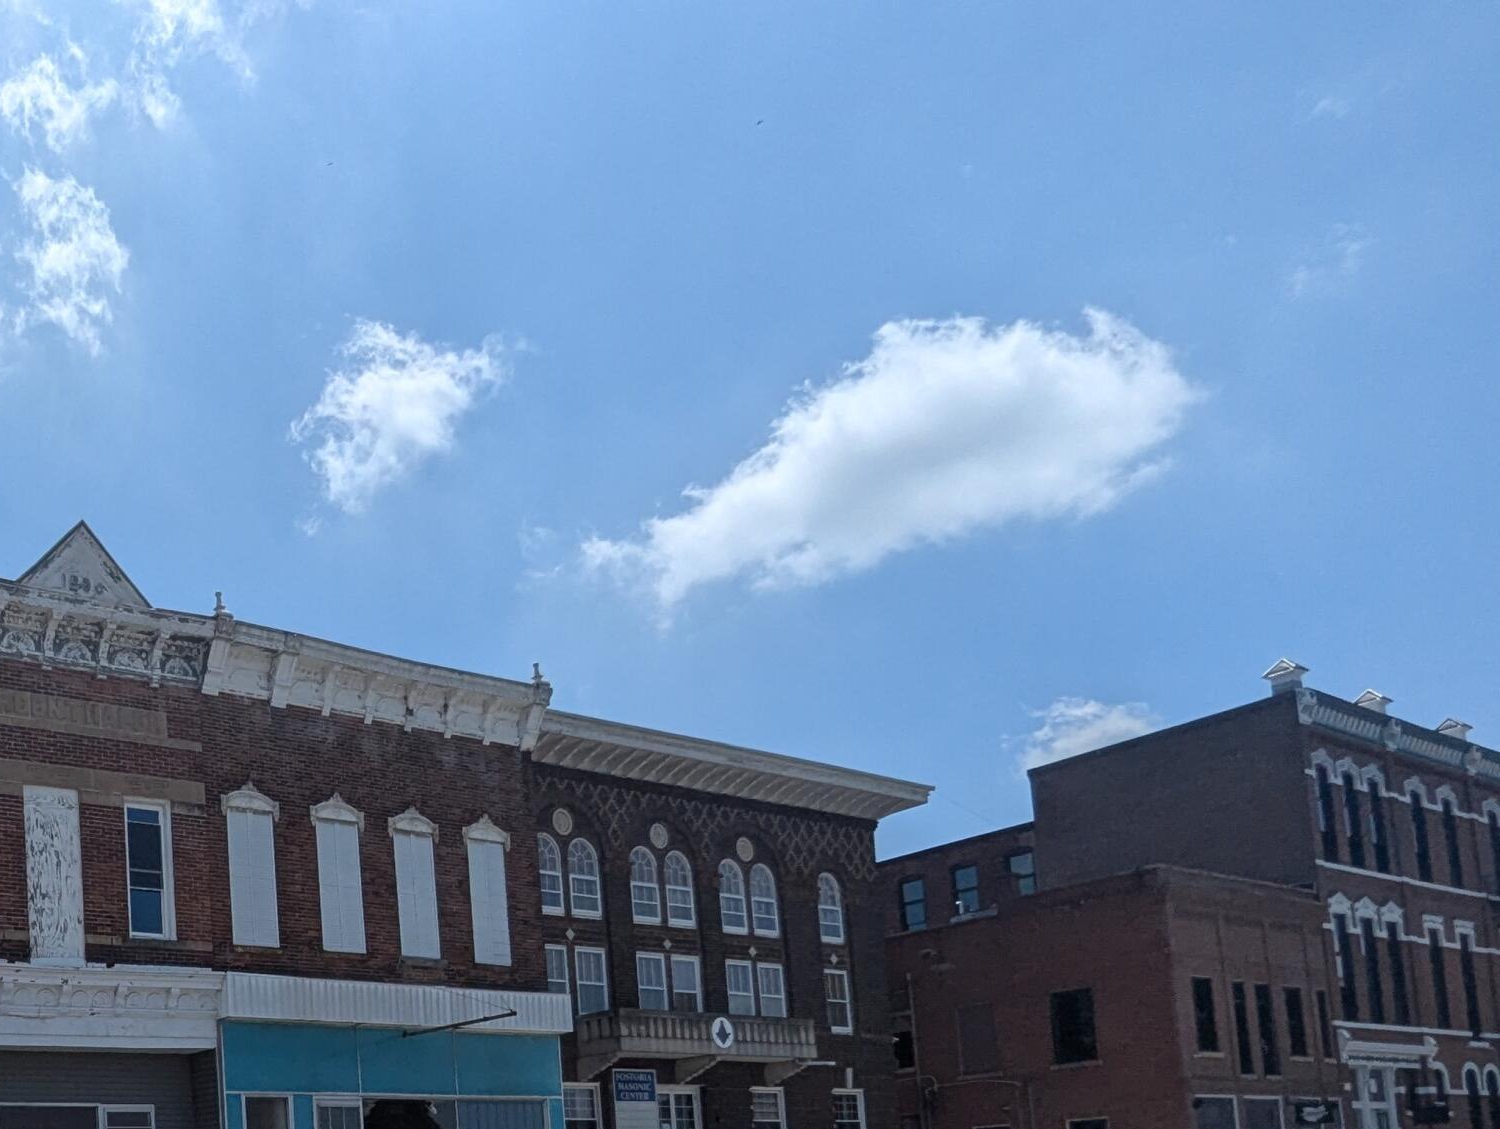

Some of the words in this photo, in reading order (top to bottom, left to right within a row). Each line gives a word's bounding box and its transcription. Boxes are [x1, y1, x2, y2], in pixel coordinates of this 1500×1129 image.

[615, 1072, 652, 1082] FOSTORIA
[618, 1082, 652, 1091] MASONIC
[620, 1091, 649, 1101] CENTER
